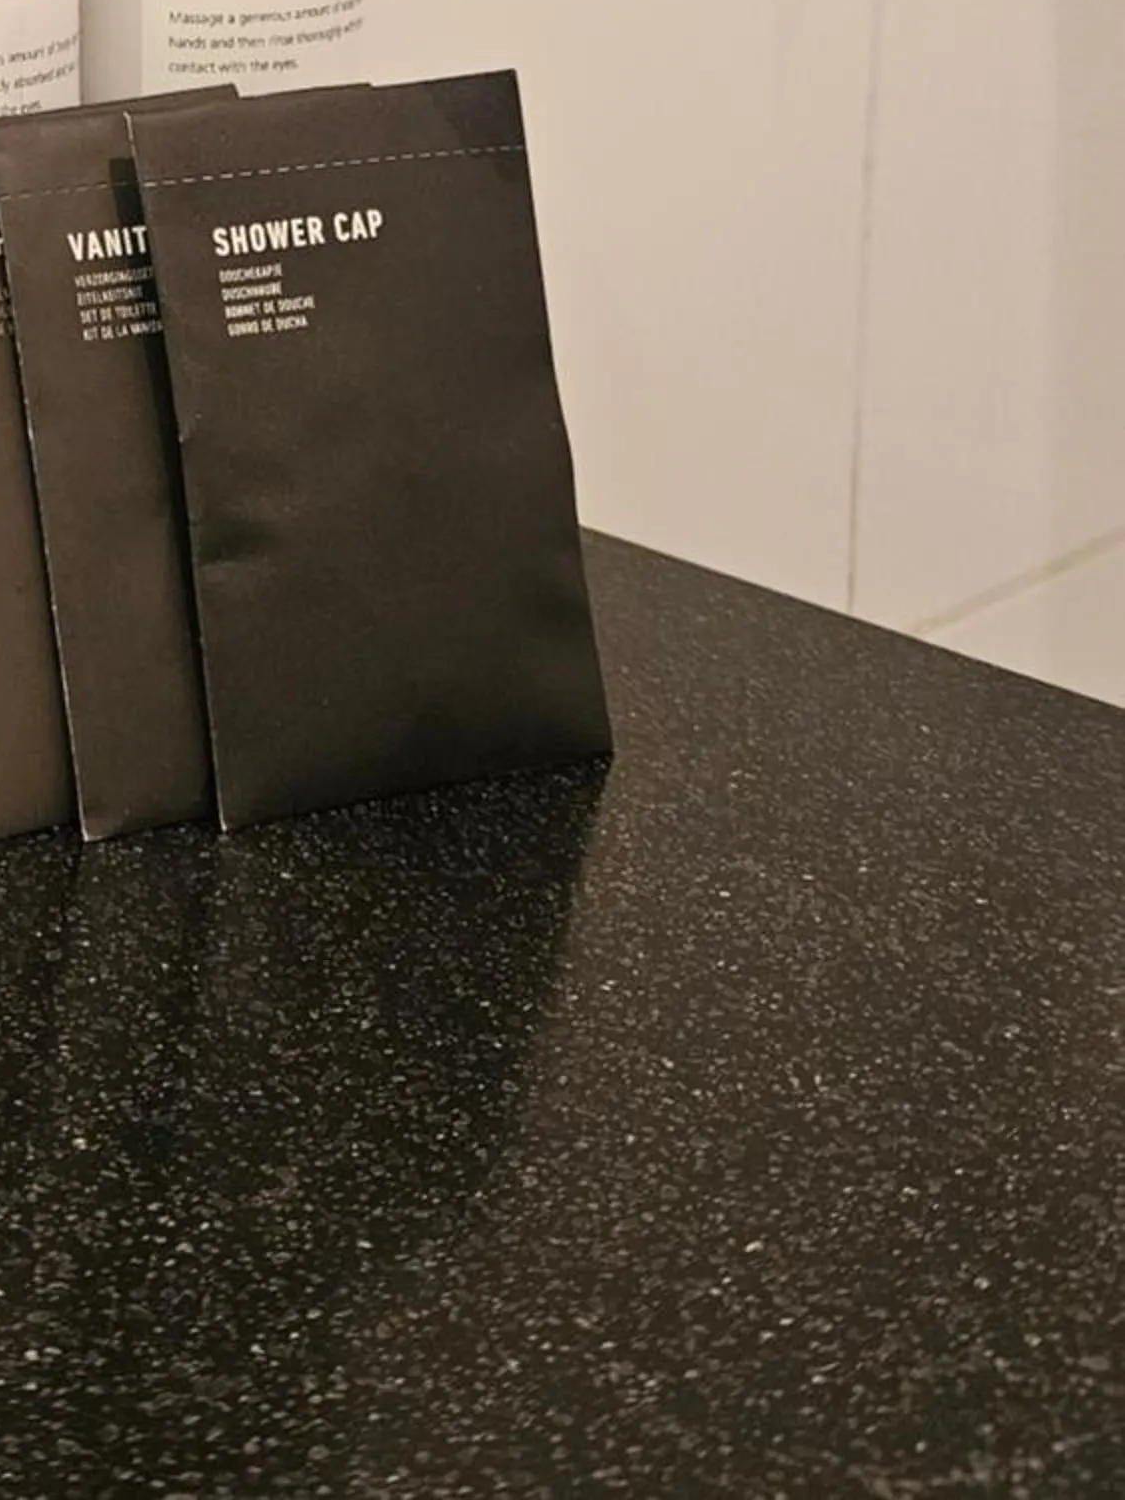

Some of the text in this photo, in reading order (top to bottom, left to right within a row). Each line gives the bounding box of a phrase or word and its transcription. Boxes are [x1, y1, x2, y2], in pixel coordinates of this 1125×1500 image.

[169, 11, 224, 27] Massage
[227, 14, 235, 24] a
[168, 35, 206, 49] hands
[210, 35, 235, 49] and
[237, 35, 265, 48] then
[168, 60, 215, 73] contact
[217, 60, 246, 73] with
[250, 58, 269, 71] the
[213, 209, 383, 257] SHOWER CAP
[67, 225, 148, 261] VANIT
